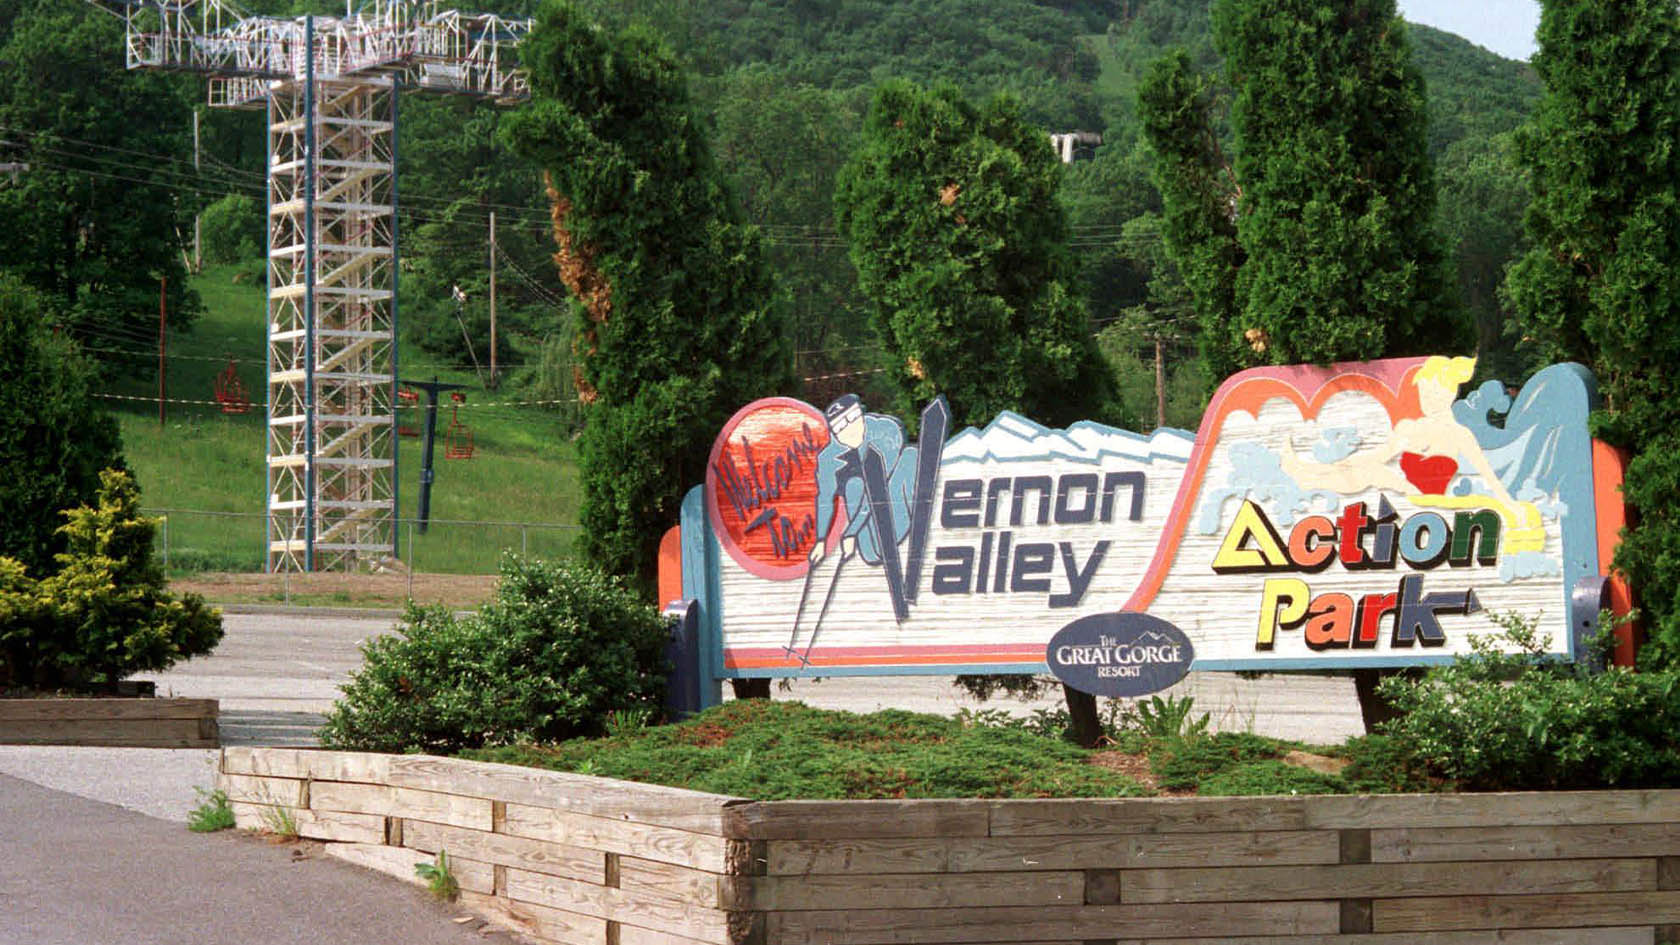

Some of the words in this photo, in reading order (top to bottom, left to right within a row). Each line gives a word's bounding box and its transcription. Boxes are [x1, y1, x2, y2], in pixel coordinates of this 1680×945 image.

[1211, 492, 1502, 574] Action
[1255, 573, 1484, 652] Park
[1099, 633, 1117, 647] THE
[1056, 645, 1113, 665] GREAT
[1115, 644, 1182, 664] GORGE
[1097, 665, 1142, 678] RESORT
